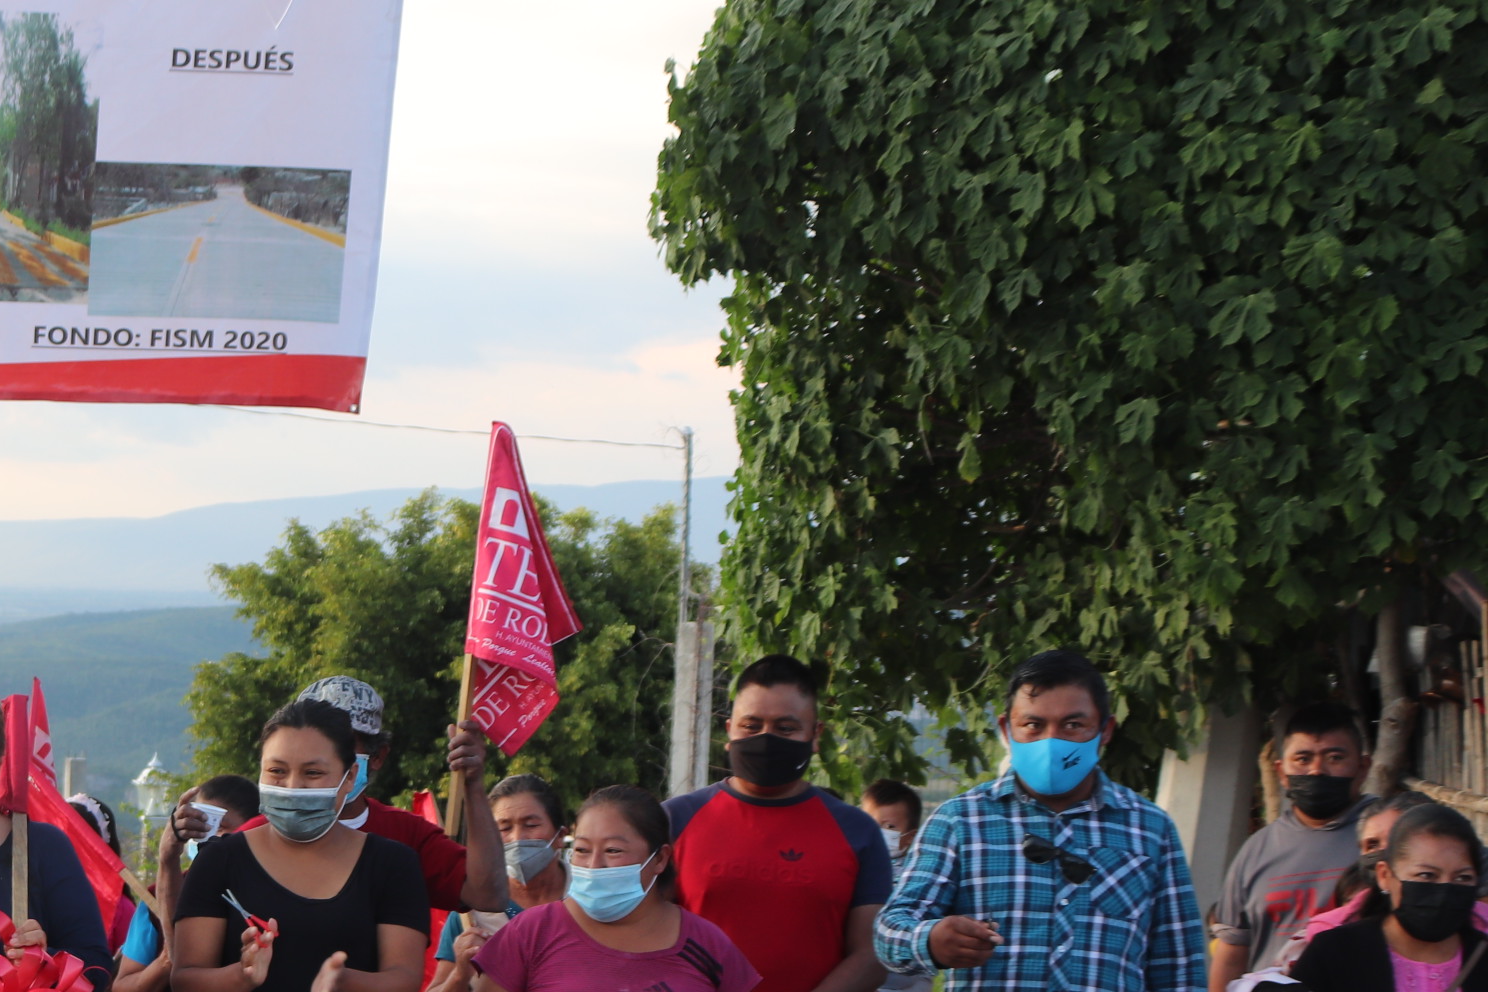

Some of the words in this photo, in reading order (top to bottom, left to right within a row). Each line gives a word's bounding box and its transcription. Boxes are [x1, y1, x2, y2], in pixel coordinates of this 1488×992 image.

[172, 45, 294, 71] DESPUÉS
[33, 325, 141, 347] FONDO:
[149, 328, 213, 348] FISM
[223, 330, 288, 351] 2020
[482, 536, 542, 602] TE
